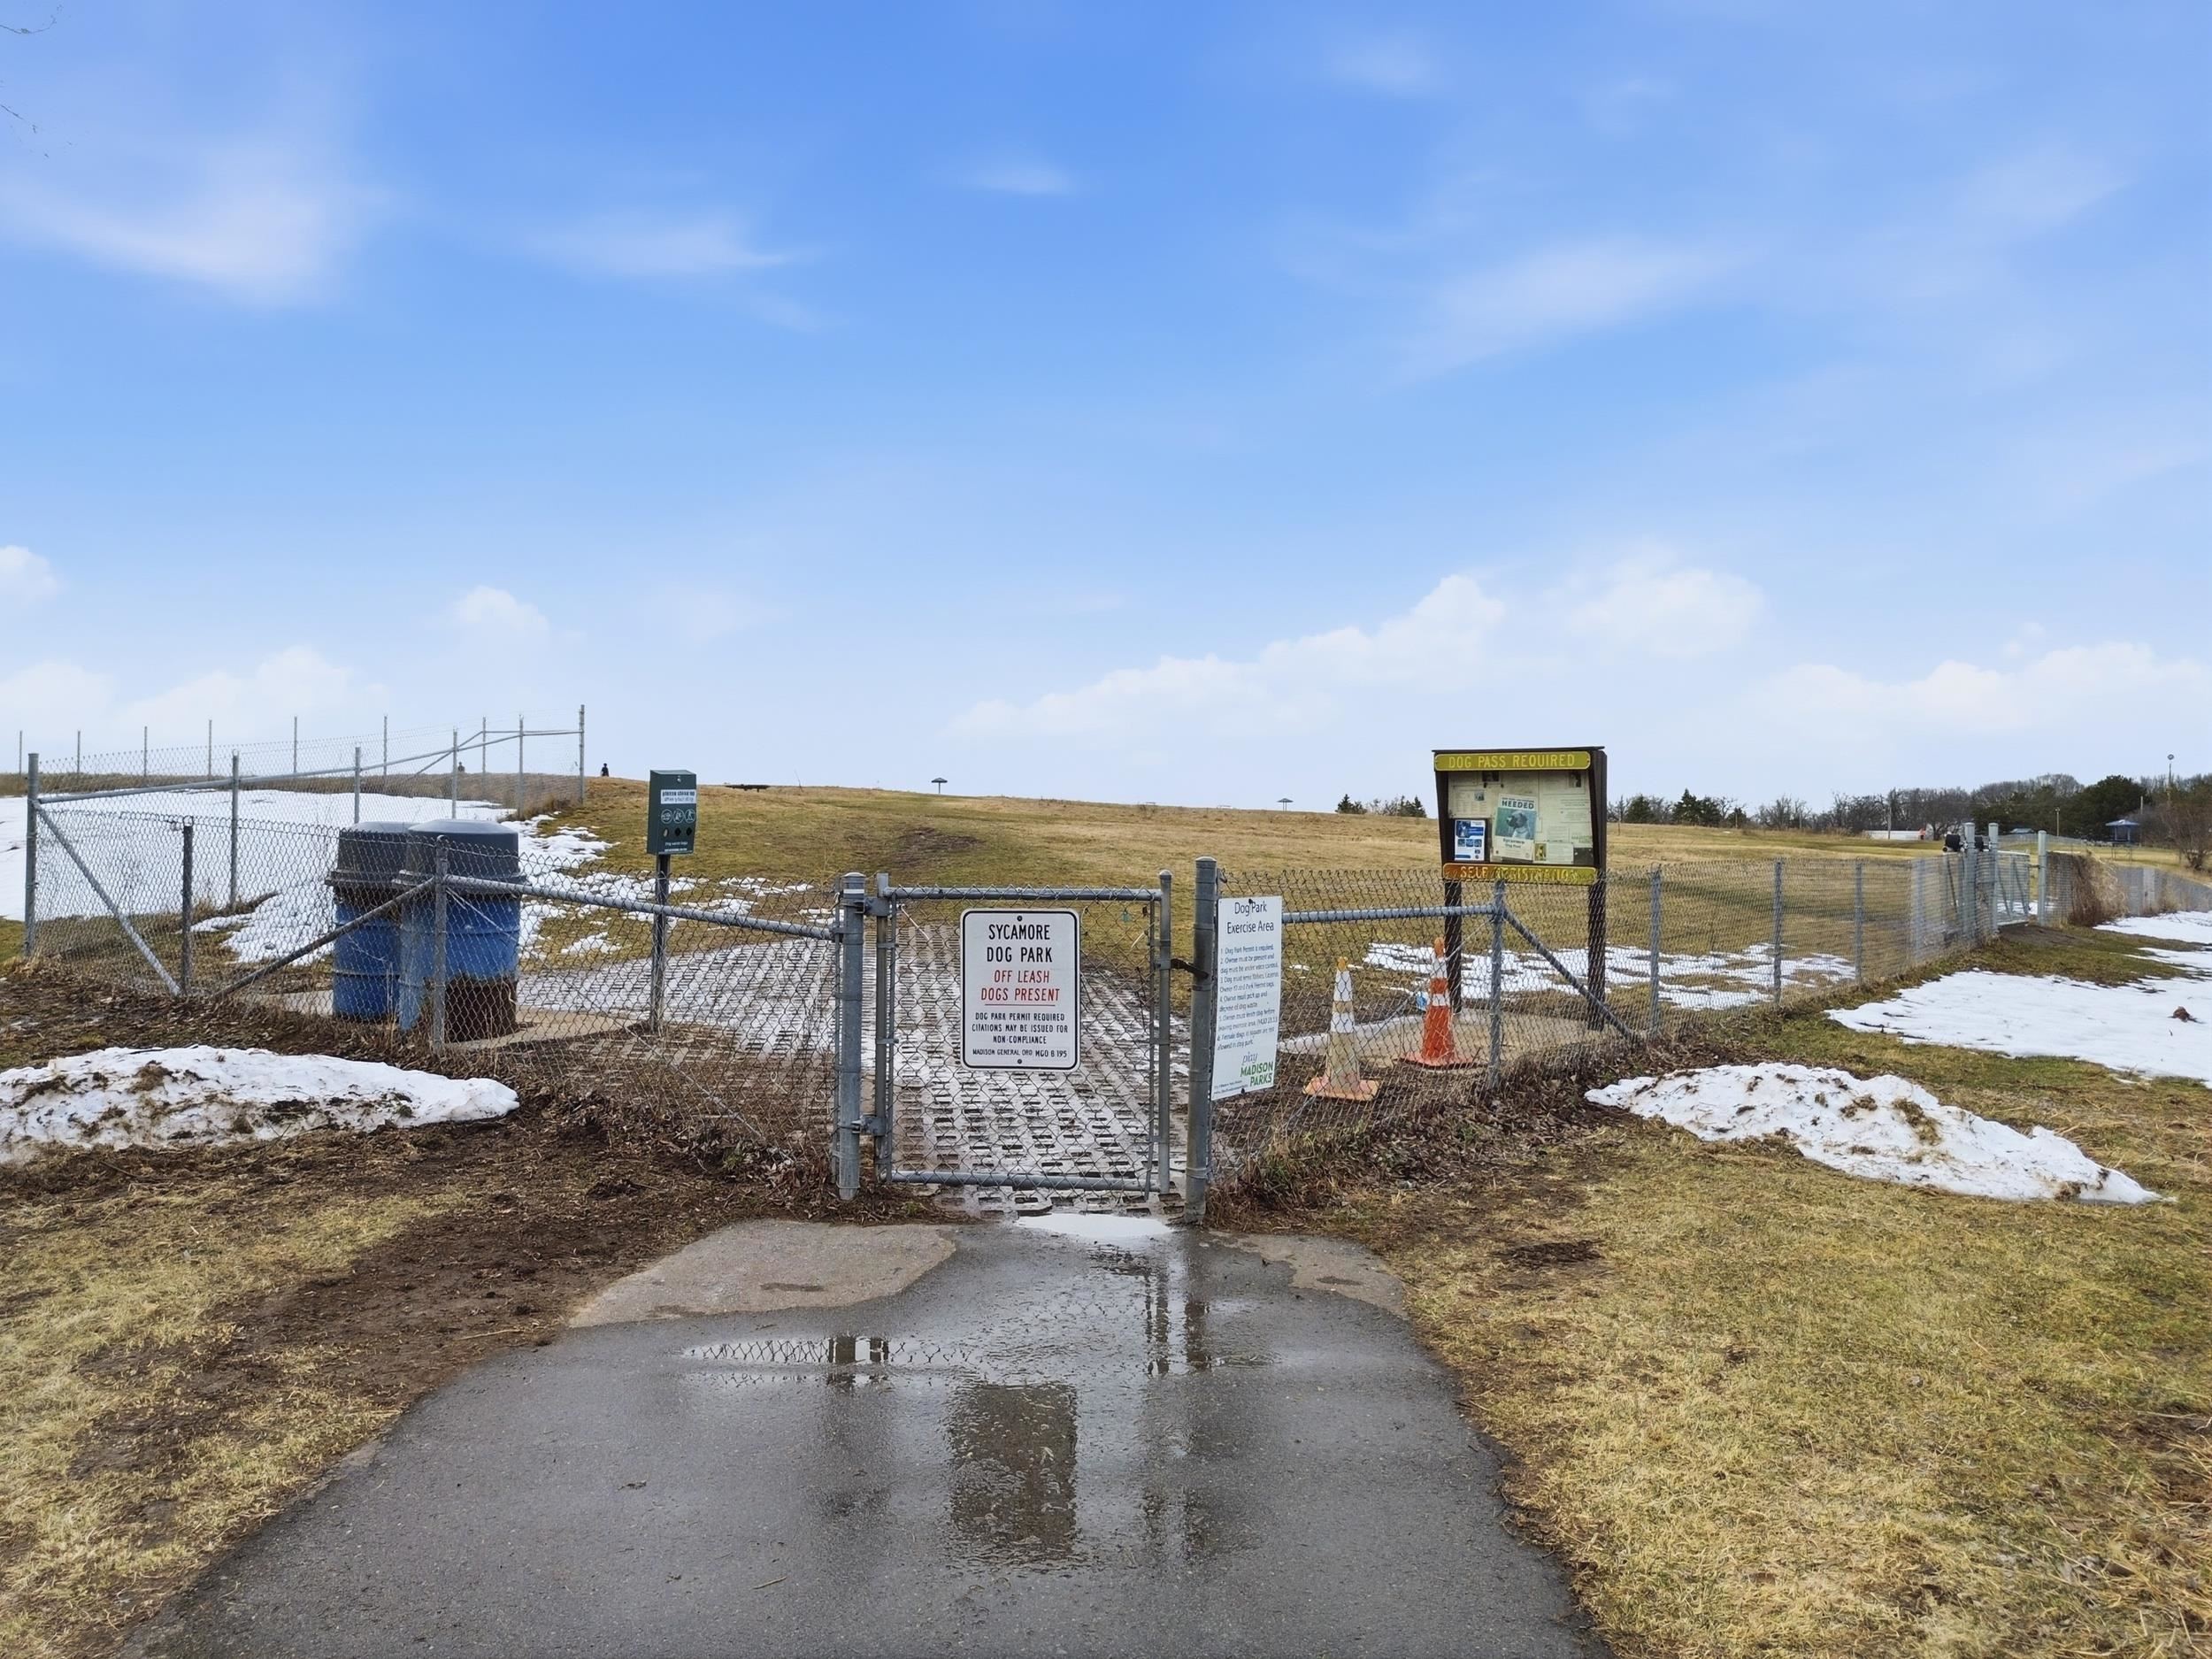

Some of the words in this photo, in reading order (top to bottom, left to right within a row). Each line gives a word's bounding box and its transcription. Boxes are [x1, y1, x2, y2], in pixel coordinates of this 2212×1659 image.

[1448, 757, 1471, 768] DOG
[1478, 755, 1506, 768] PASS
[1512, 754, 1575, 767] REQUIRED
[1460, 865, 1489, 879] SELF
[1234, 902, 1250, 917] Dog
[1251, 900, 1267, 913] Park
[988, 924, 1051, 941] SYCAMORE
[1226, 921, 1256, 934] Exercise
[1257, 920, 1274, 932] Area
[987, 947, 1012, 963] DOG
[1020, 947, 1053, 963] PARK
[994, 970, 1013, 983] OFF
[1018, 970, 1049, 984] LEASH
[980, 987, 1009, 1001] DOGS
[1014, 987, 1061, 1002] PRESENT
[1009, 1012, 1031, 1021] PERMIT
[1056, 1025, 1068, 1033] FOR
[993, 1035, 1047, 1044] NON-COMPLIANCE
[1240, 1061, 1274, 1077] MADISON
[1249, 1072, 1273, 1087] PARKS
